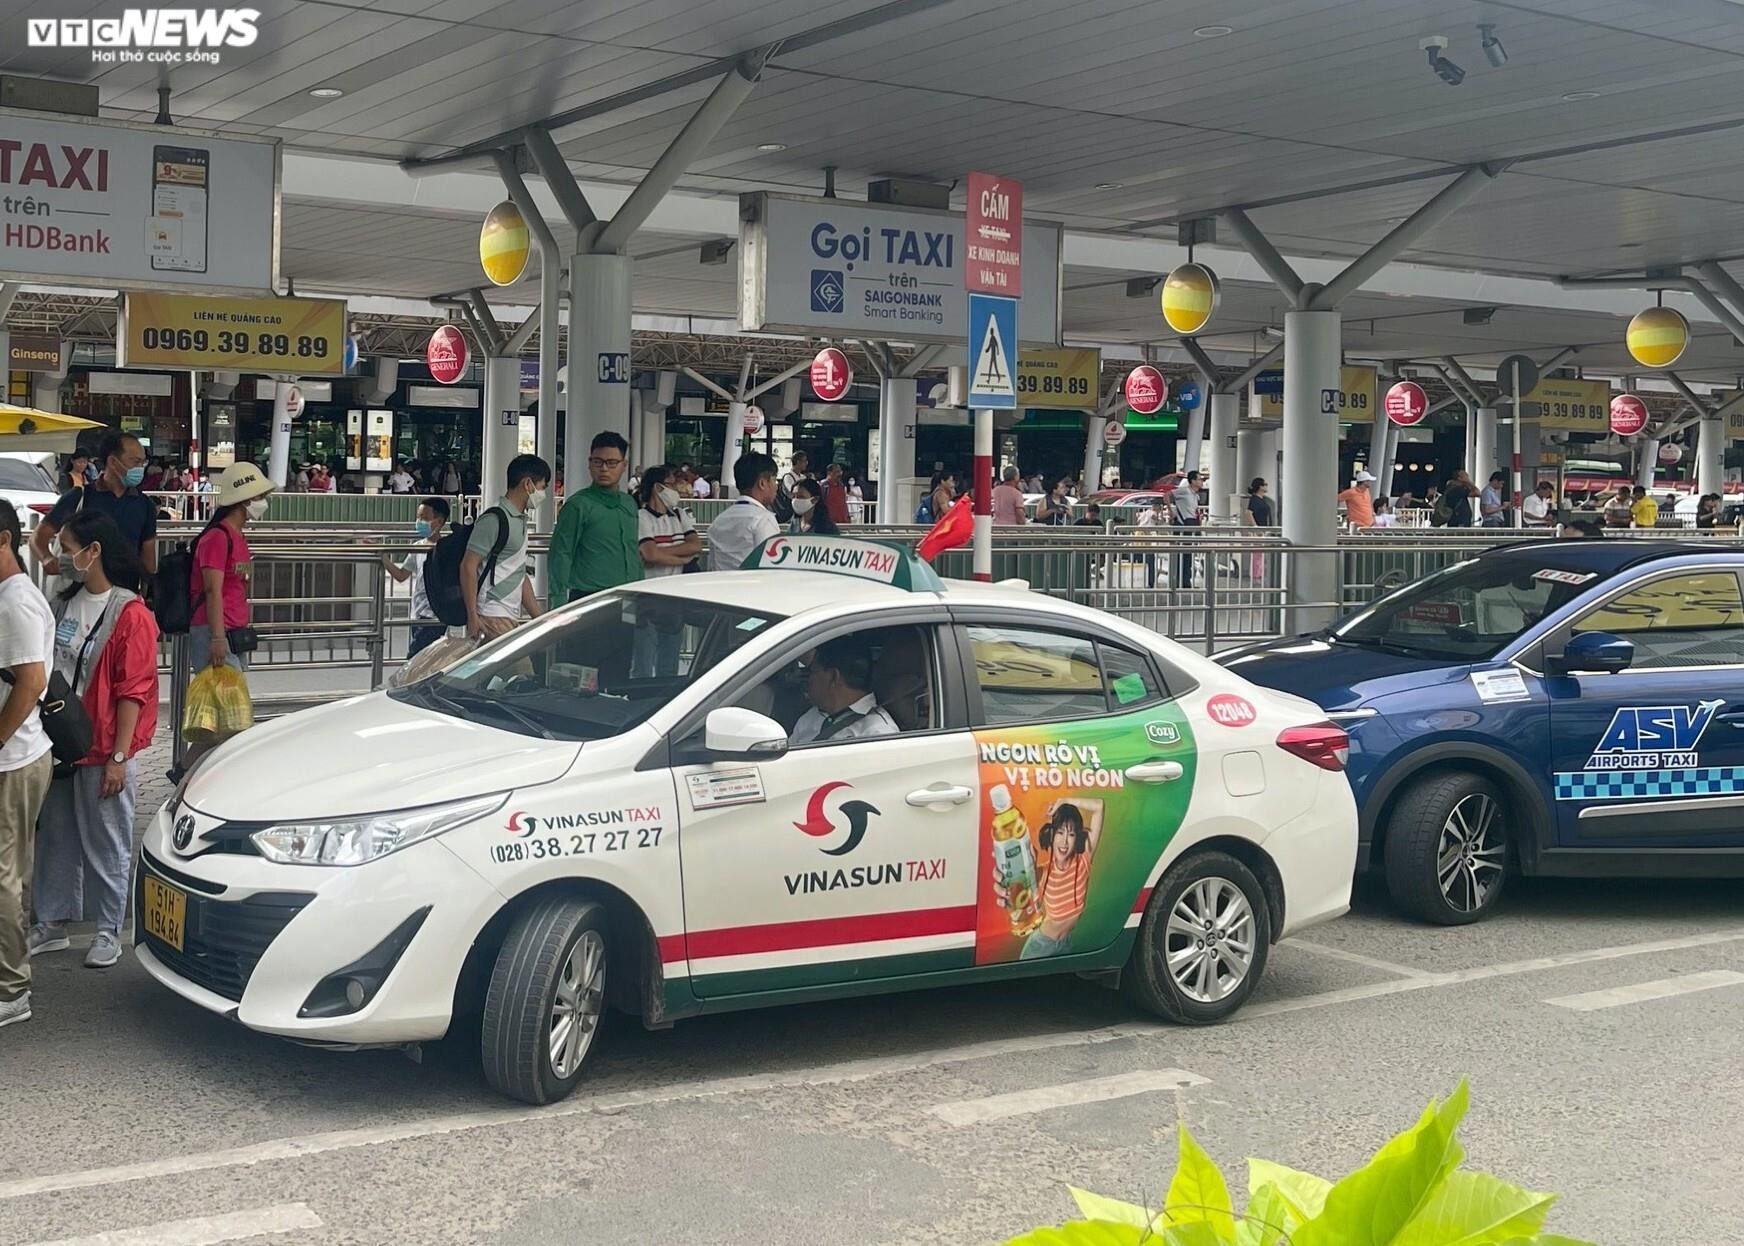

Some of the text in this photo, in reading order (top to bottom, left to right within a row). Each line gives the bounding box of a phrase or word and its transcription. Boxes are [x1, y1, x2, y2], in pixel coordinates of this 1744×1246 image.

[0, 139, 109, 193] TAXI
[5, 196, 50, 216] trên
[980, 184, 1009, 220] CẤM
[6, 224, 110, 254] HDBank
[811, 222, 953, 271] Gọi TAXI
[968, 245, 1020, 266] XE KINH DOANH
[889, 273, 917, 288] trên
[865, 290, 942, 307] SAIGONBANK
[864, 305, 943, 324] Smart Banking
[11, 348, 58, 363] Ginseng
[143, 327, 328, 358] 0969.39.89.89
[796, 545, 896, 573] VINASUN TAXI
[1212, 702, 1254, 721] 12048
[1149, 725, 1175, 739] Cozy
[1594, 704, 1718, 753] ASV
[979, 739, 1101, 769] NGON RÕ VỊ
[1585, 752, 1698, 769] AIRPORTS TAXI
[1004, 763, 1124, 792] VỊ RÕ NGON
[543, 807, 661, 830] VINASUN TAXI
[604, 830, 629, 851] 27
[637, 827, 663, 848] 27
[784, 858, 946, 895] VINASUN TAXI
[157, 885, 175, 916] 51H
